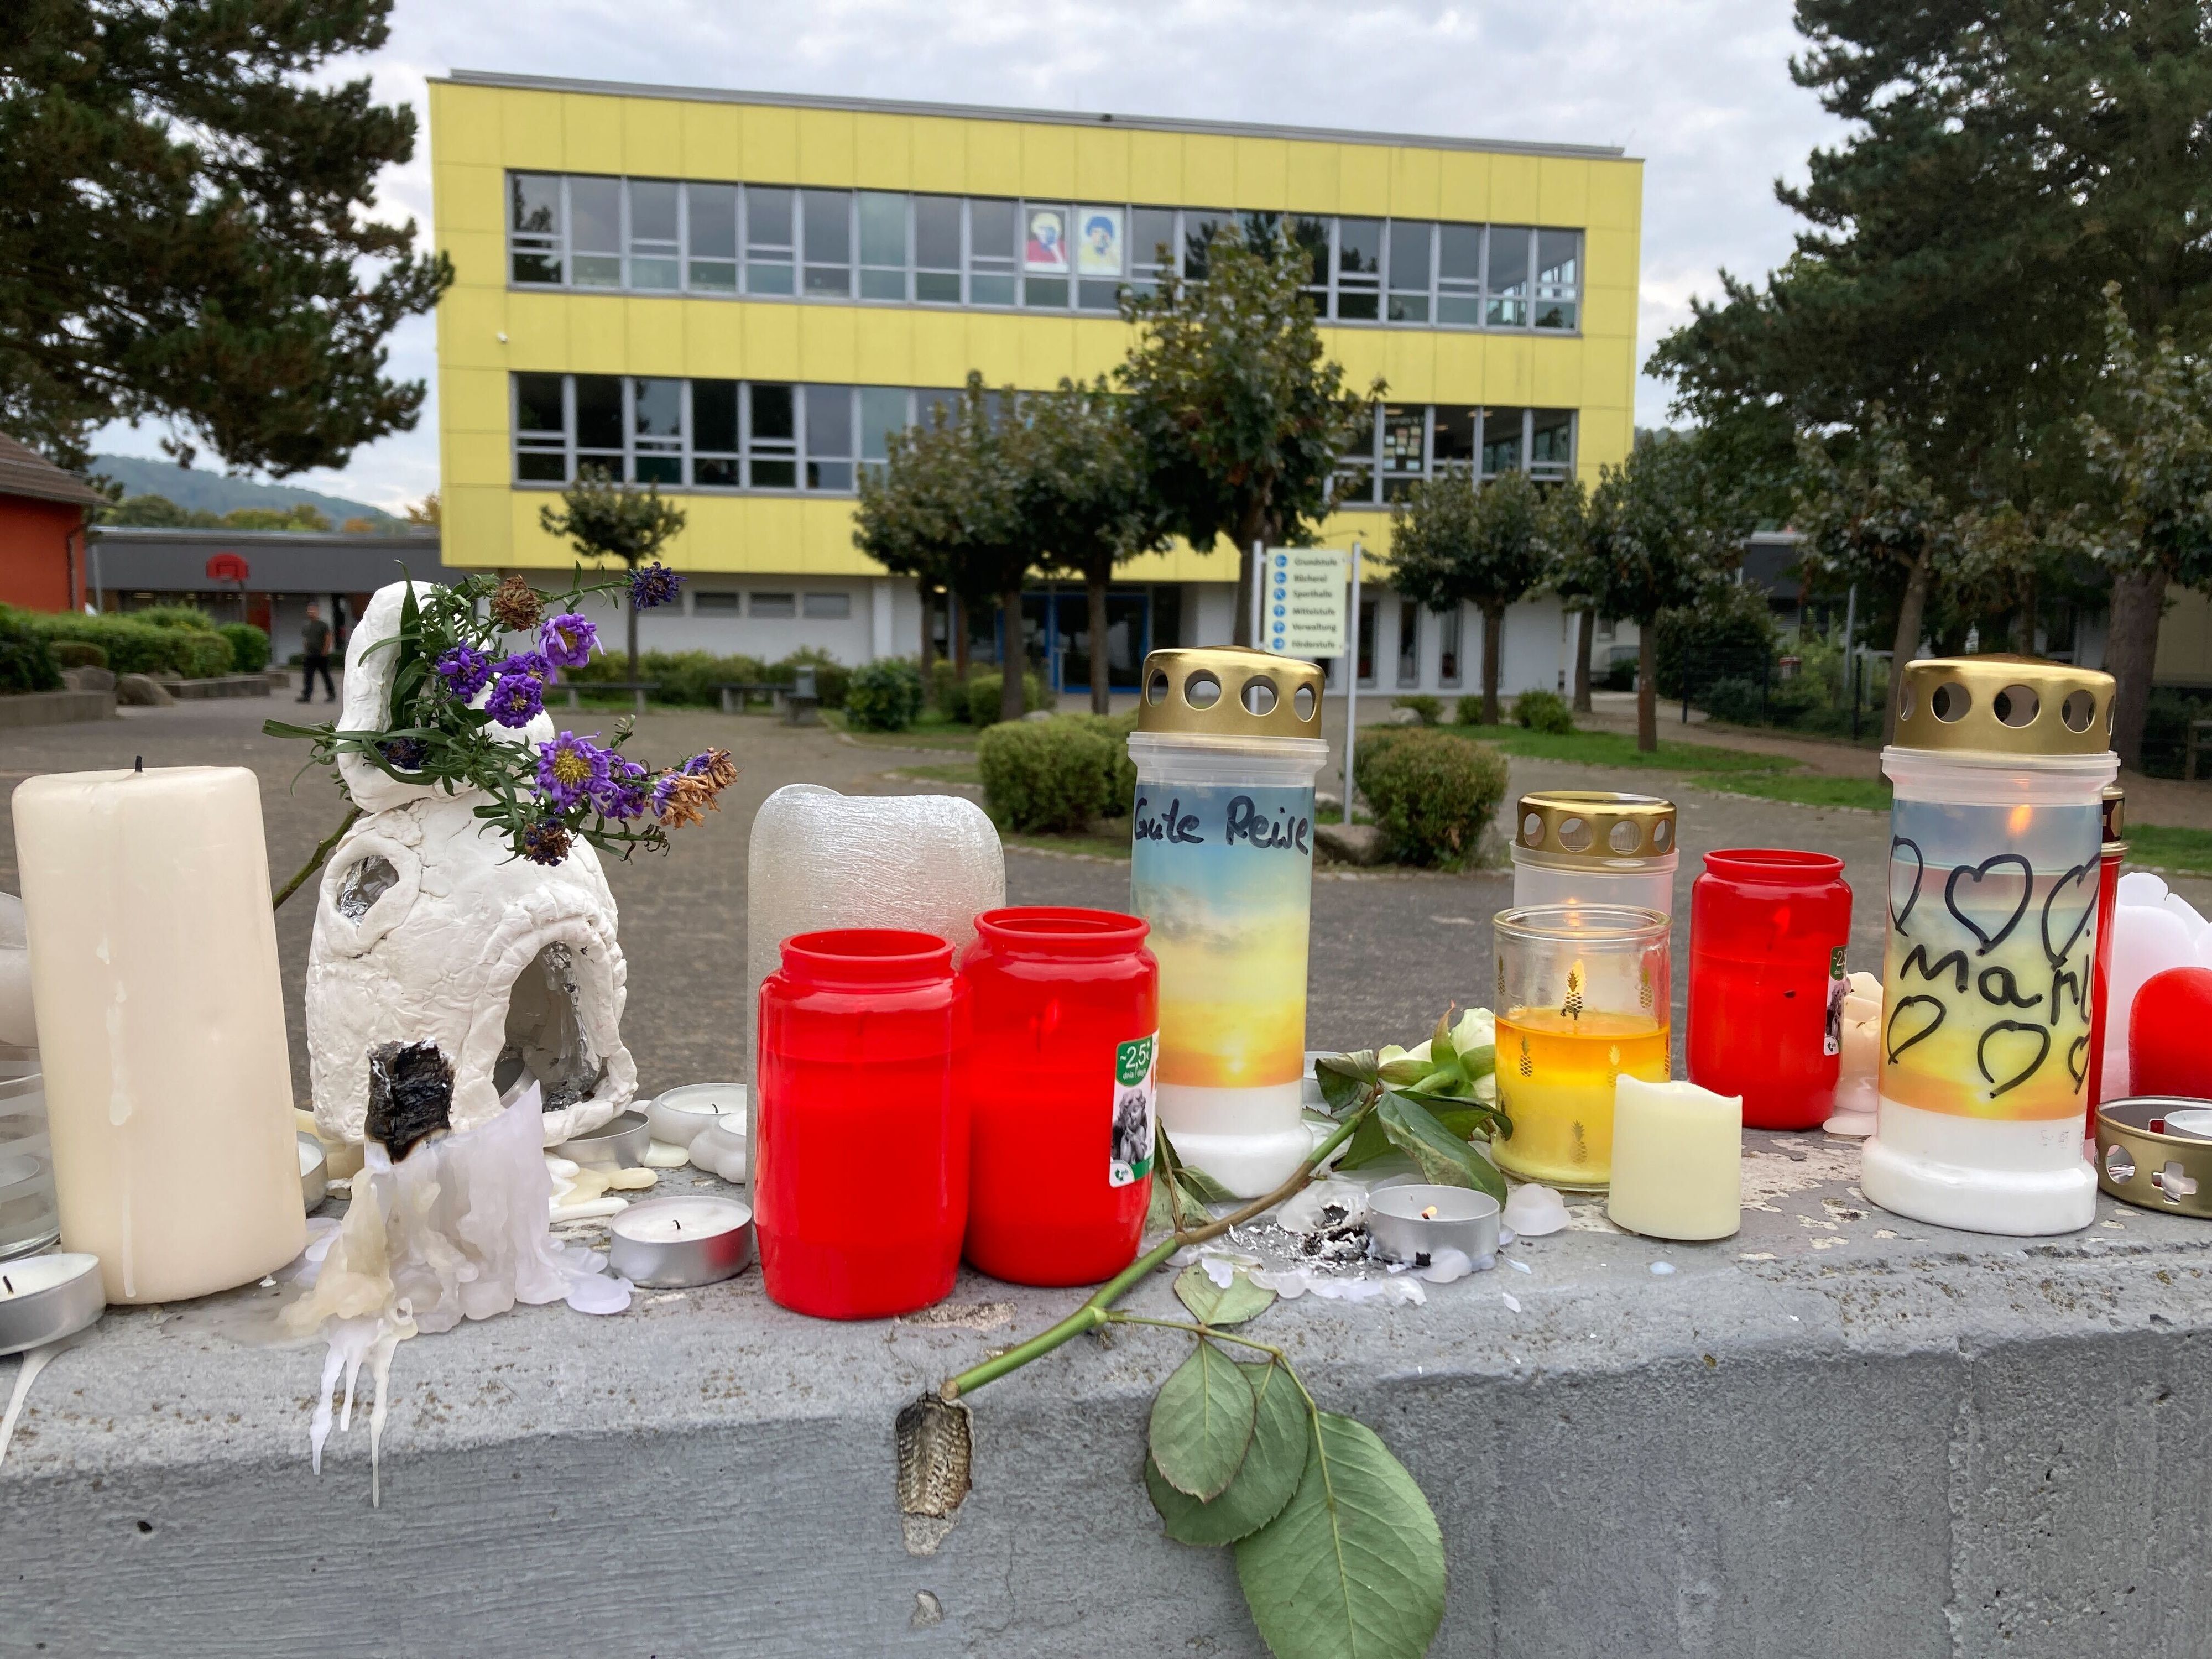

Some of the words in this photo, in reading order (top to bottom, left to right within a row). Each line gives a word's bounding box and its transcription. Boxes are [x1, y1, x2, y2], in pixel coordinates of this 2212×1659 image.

[1294, 557, 1337, 566] Grundstufe
[1293, 573, 1327, 582] Bücherei
[1293, 589, 1333, 599] Sporthalle
[1292, 607, 1335, 615] Mittelstufe
[1292, 623, 1337, 633] Verwaltung
[1291, 640, 1335, 648] Förderstufe
[1134, 797, 1204, 844] Gute
[1225, 795, 1309, 855] Reise
